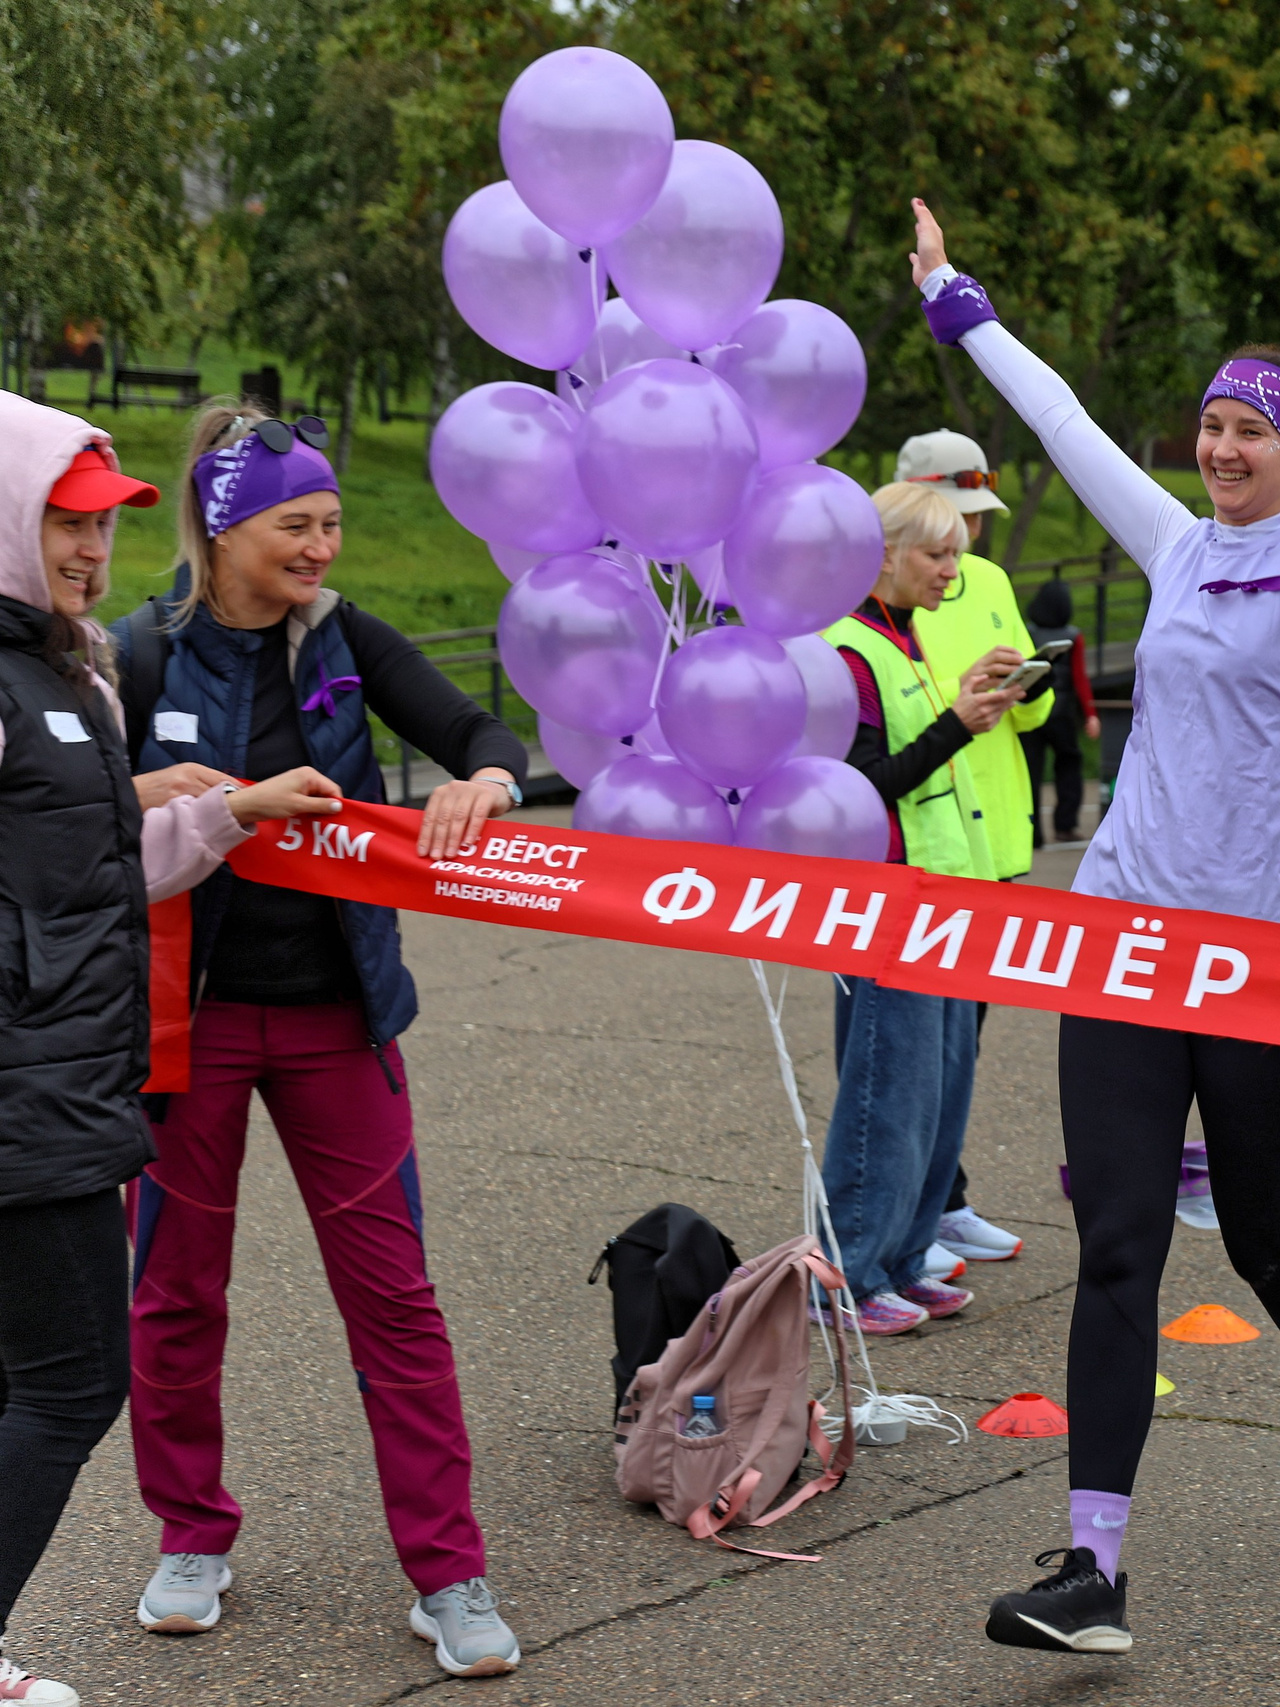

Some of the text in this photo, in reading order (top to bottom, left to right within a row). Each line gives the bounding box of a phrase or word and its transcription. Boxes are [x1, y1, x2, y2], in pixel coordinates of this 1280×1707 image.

[206, 439, 244, 538] RAIL
[276, 817, 376, 863] 5 КМ
[457, 834, 588, 870] 5 ВЁРСТ
[429, 859, 586, 893] КРАСНОЯРСК
[435, 880, 562, 912] НАБЕРЕЖНАЯ
[642, 867, 1251, 1009] ФИНИШЁР
